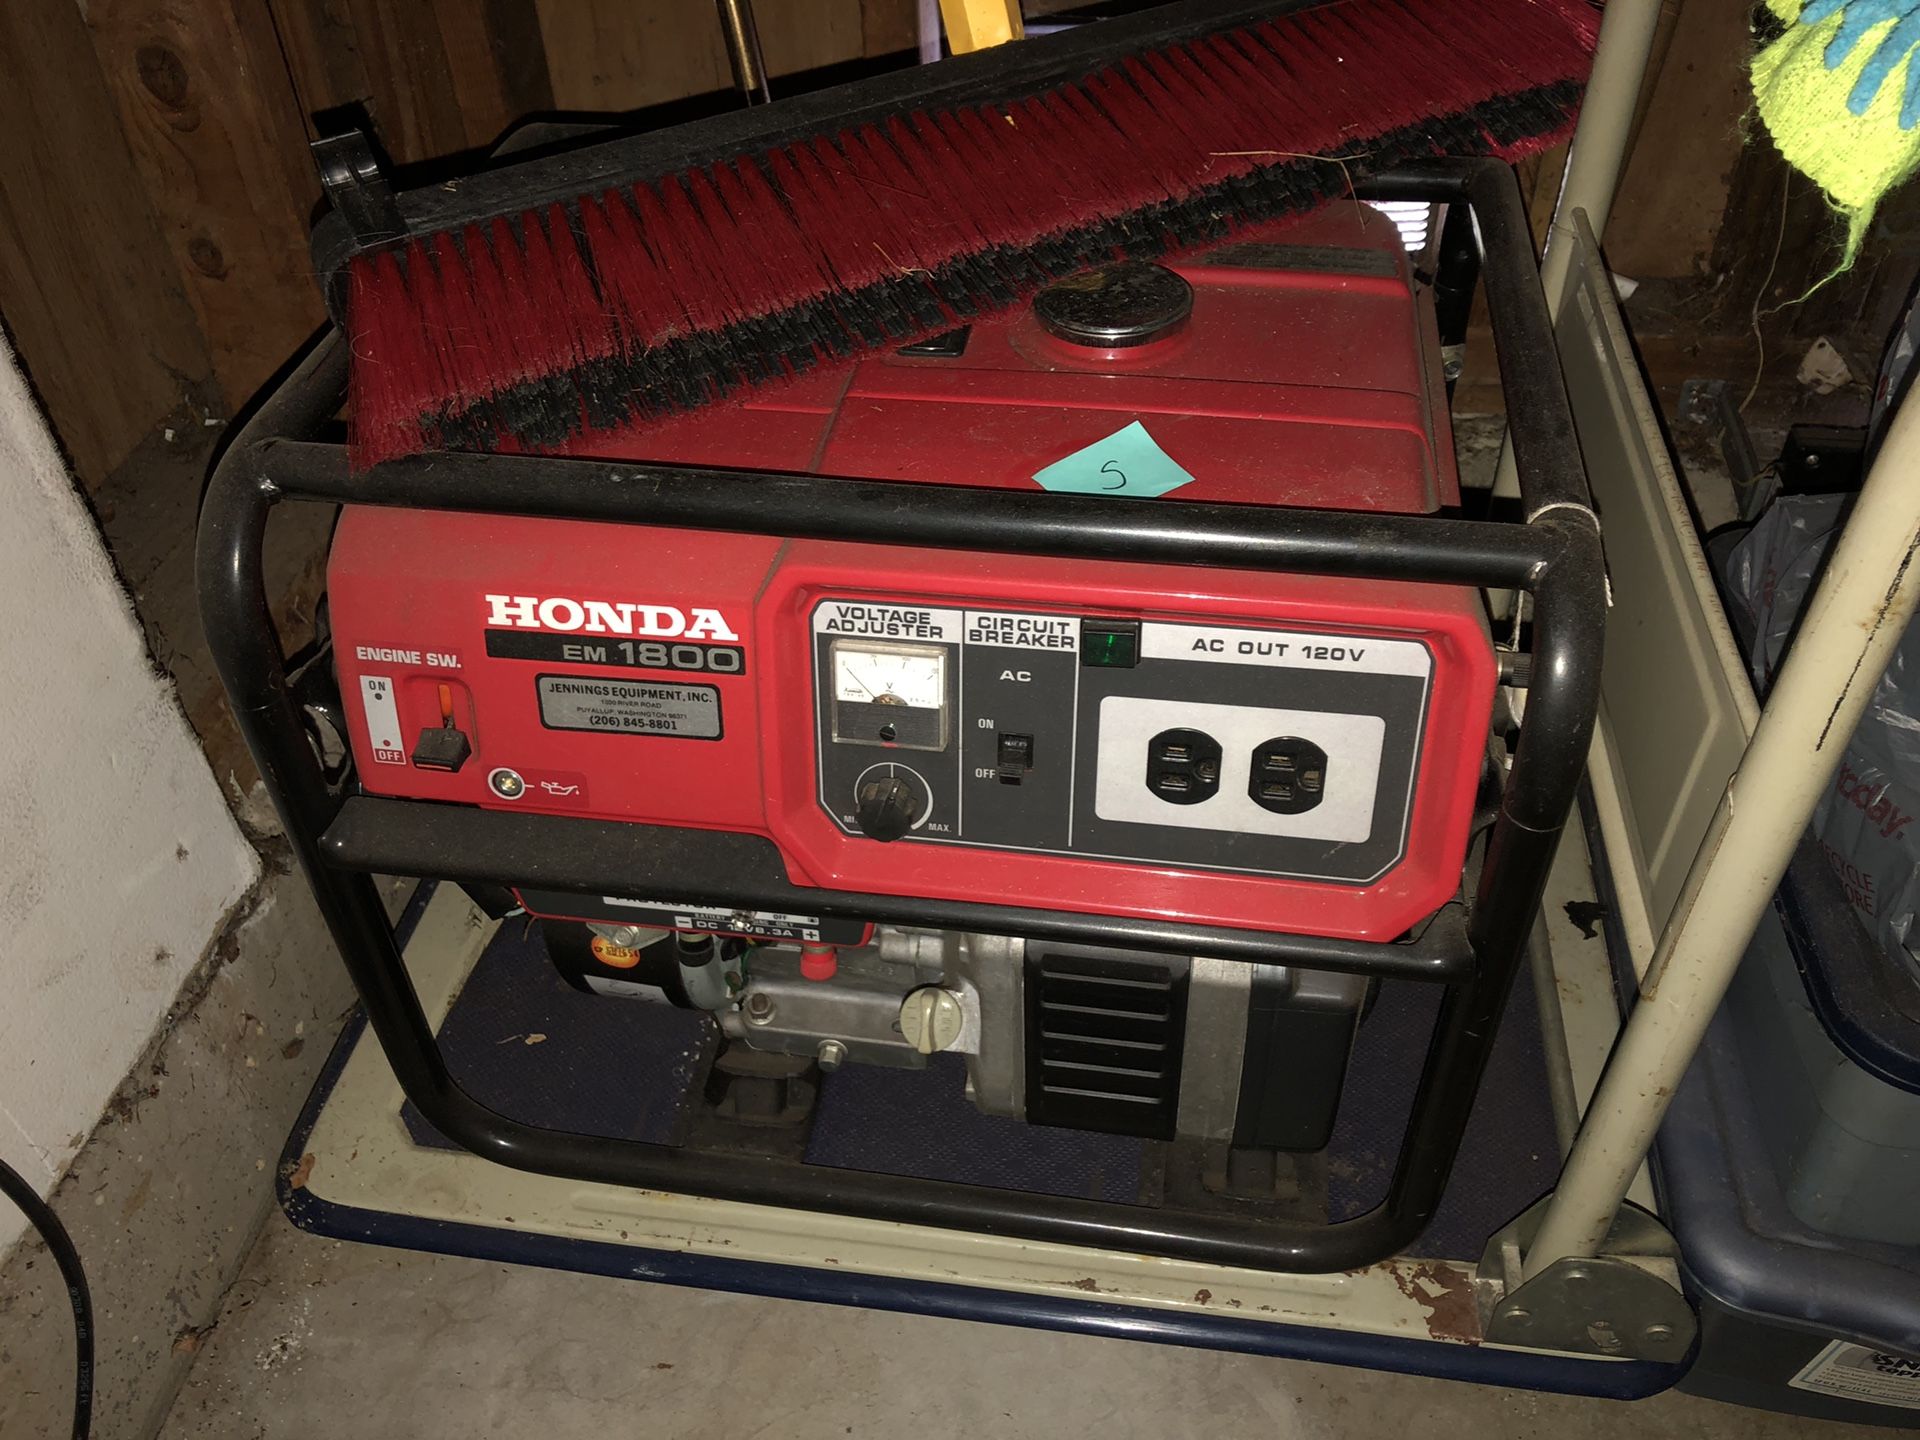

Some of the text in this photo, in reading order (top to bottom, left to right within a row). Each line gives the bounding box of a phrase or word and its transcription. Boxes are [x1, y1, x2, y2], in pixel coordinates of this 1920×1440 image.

[485, 594, 738, 641] HONDA
[836, 605, 931, 625] VOLTAGE
[826, 618, 943, 639] ADJUSTER
[977, 616, 1070, 635] CIRCUIT
[969, 629, 1075, 649] BREAKER
[356, 646, 462, 669] ENGINE SW.
[563, 642, 740, 672] EM 1800
[1192, 638, 1365, 662] AC OUT 120V
[999, 670, 1032, 682] AC
[368, 679, 387, 692] ON
[549, 683, 609, 696] JENNINGS
[687, 691, 713, 703] INC.
[617, 700, 640, 708] RIVER
[640, 701, 662, 709] ROAD
[617, 709, 668, 719] WASHINGTON
[590, 715, 677, 731] (206) 845-8801
[978, 718, 994, 729] ON
[378, 749, 401, 762] OFF
[975, 768, 996, 779] OFF
[696, 920, 719, 930] DC
